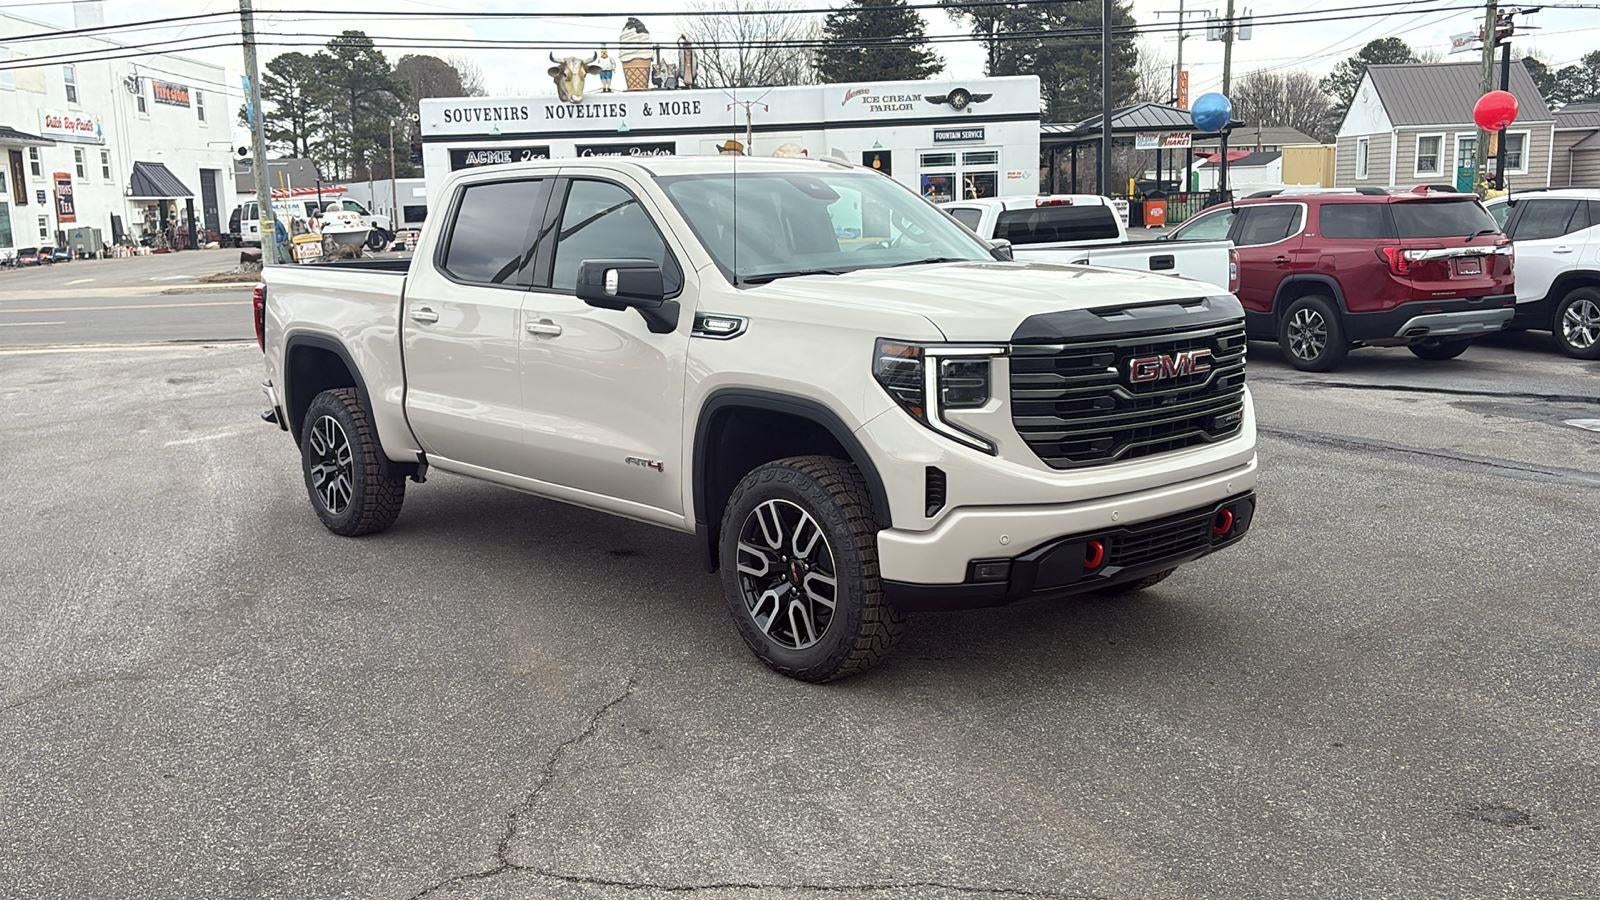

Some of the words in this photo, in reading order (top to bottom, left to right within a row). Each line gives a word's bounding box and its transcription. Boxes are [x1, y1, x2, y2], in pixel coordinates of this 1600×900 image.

[862, 96, 880, 104] ICE
[882, 94, 922, 103] CREAM
[444, 106, 528, 122] SOUVENIRS
[545, 103, 627, 119] NOVELTIES
[642, 102, 653, 117] &
[659, 100, 701, 116] MORE
[870, 103, 914, 112] PARLOR
[45, 114, 62, 129] Dutch
[64, 116, 74, 133] Boy
[76, 117, 93, 132] Paints
[935, 131, 961, 140] FOUNTAIN
[961, 130, 983, 139] SERVICE
[466, 150, 512, 165] ACME
[520, 149, 547, 161] Ice
[580, 148, 623, 158] Cream
[629, 147, 673, 158] Parlor
[60, 200, 74, 214] TEA
[1130, 349, 1211, 383] GMC
[624, 456, 665, 473] AT4
